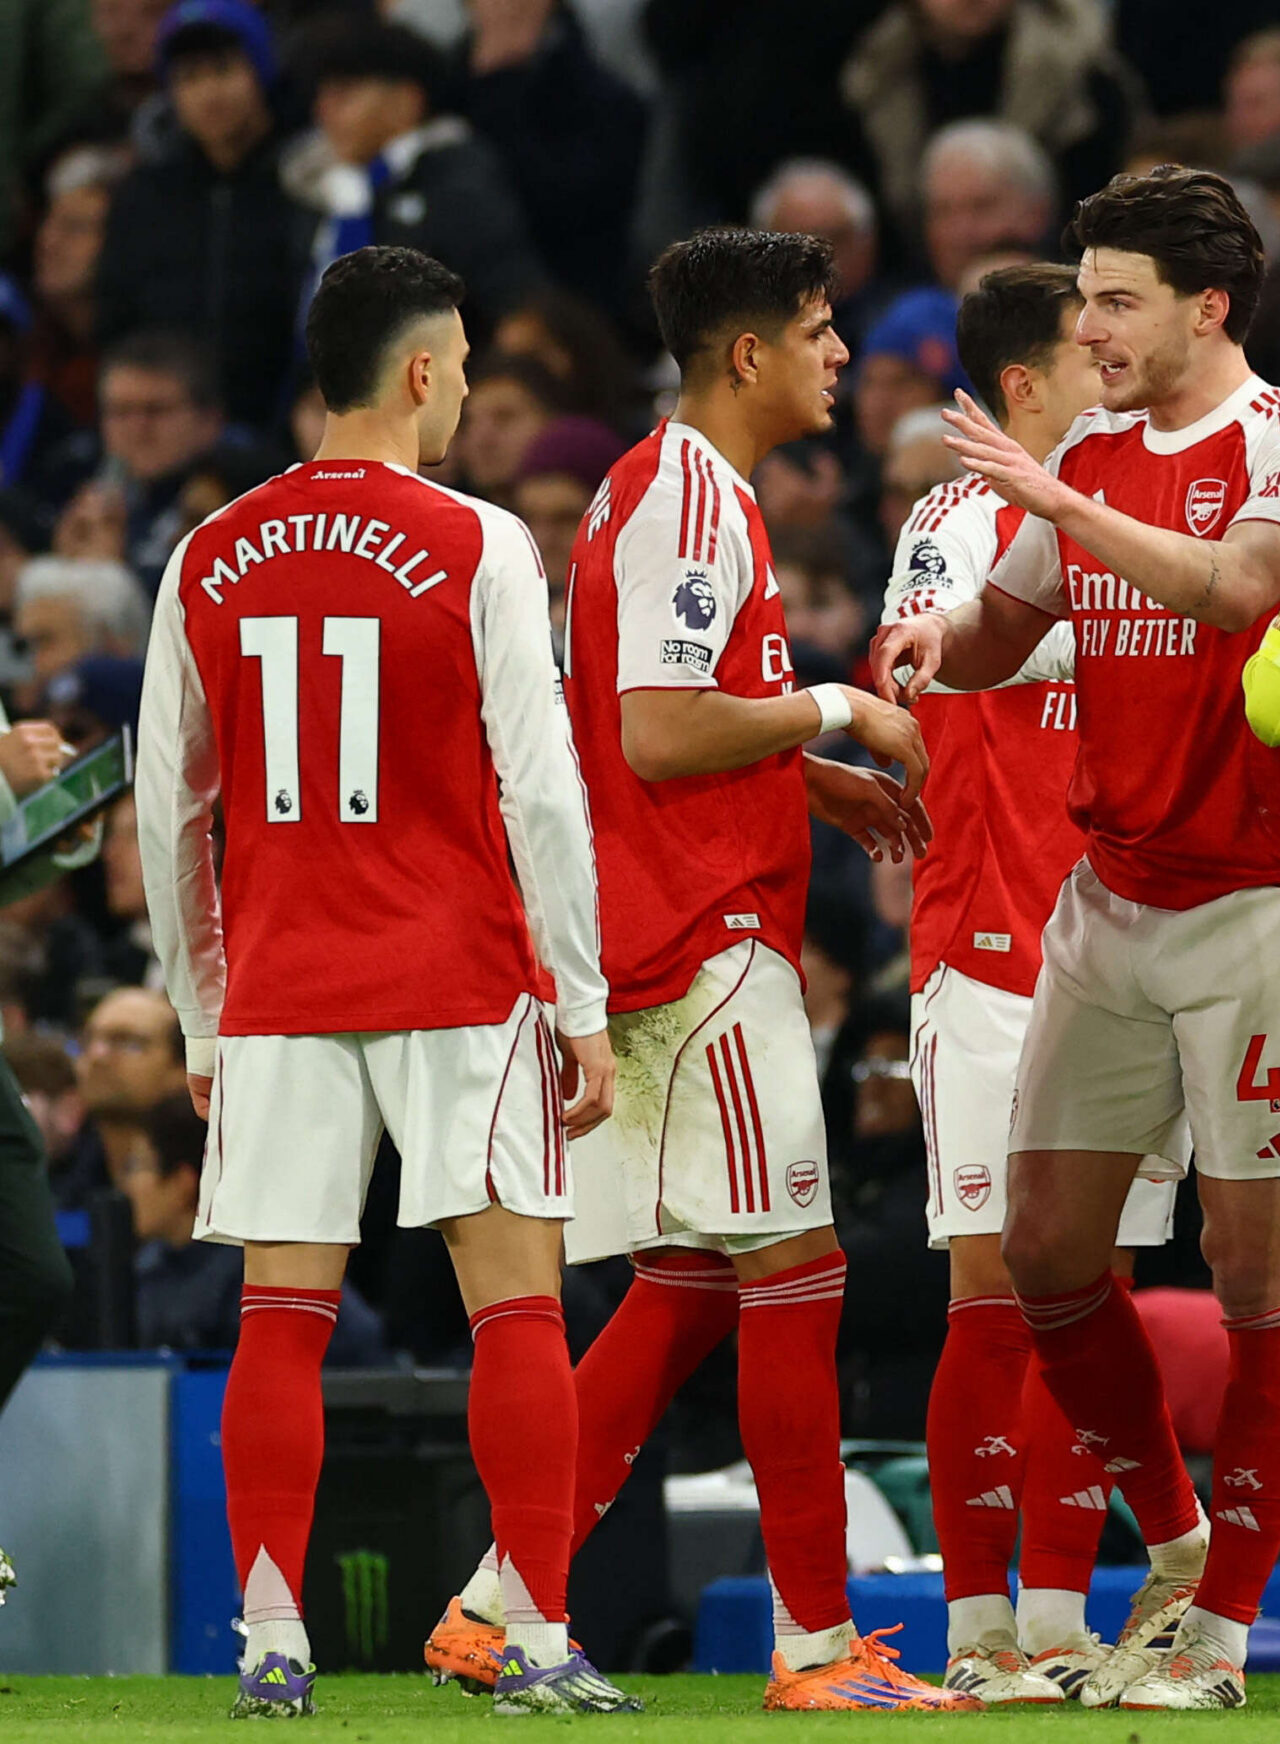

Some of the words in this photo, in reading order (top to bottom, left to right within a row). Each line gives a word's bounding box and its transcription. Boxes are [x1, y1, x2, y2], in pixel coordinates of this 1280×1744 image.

[1193, 489, 1223, 499] Arsenal
[200, 513, 448, 605] MARTINELLI
[661, 640, 681, 652] No
[682, 643, 709, 661] room
[1082, 619, 1111, 656] FLY
[1114, 618, 1197, 656] BETTER
[239, 616, 381, 823] 11
